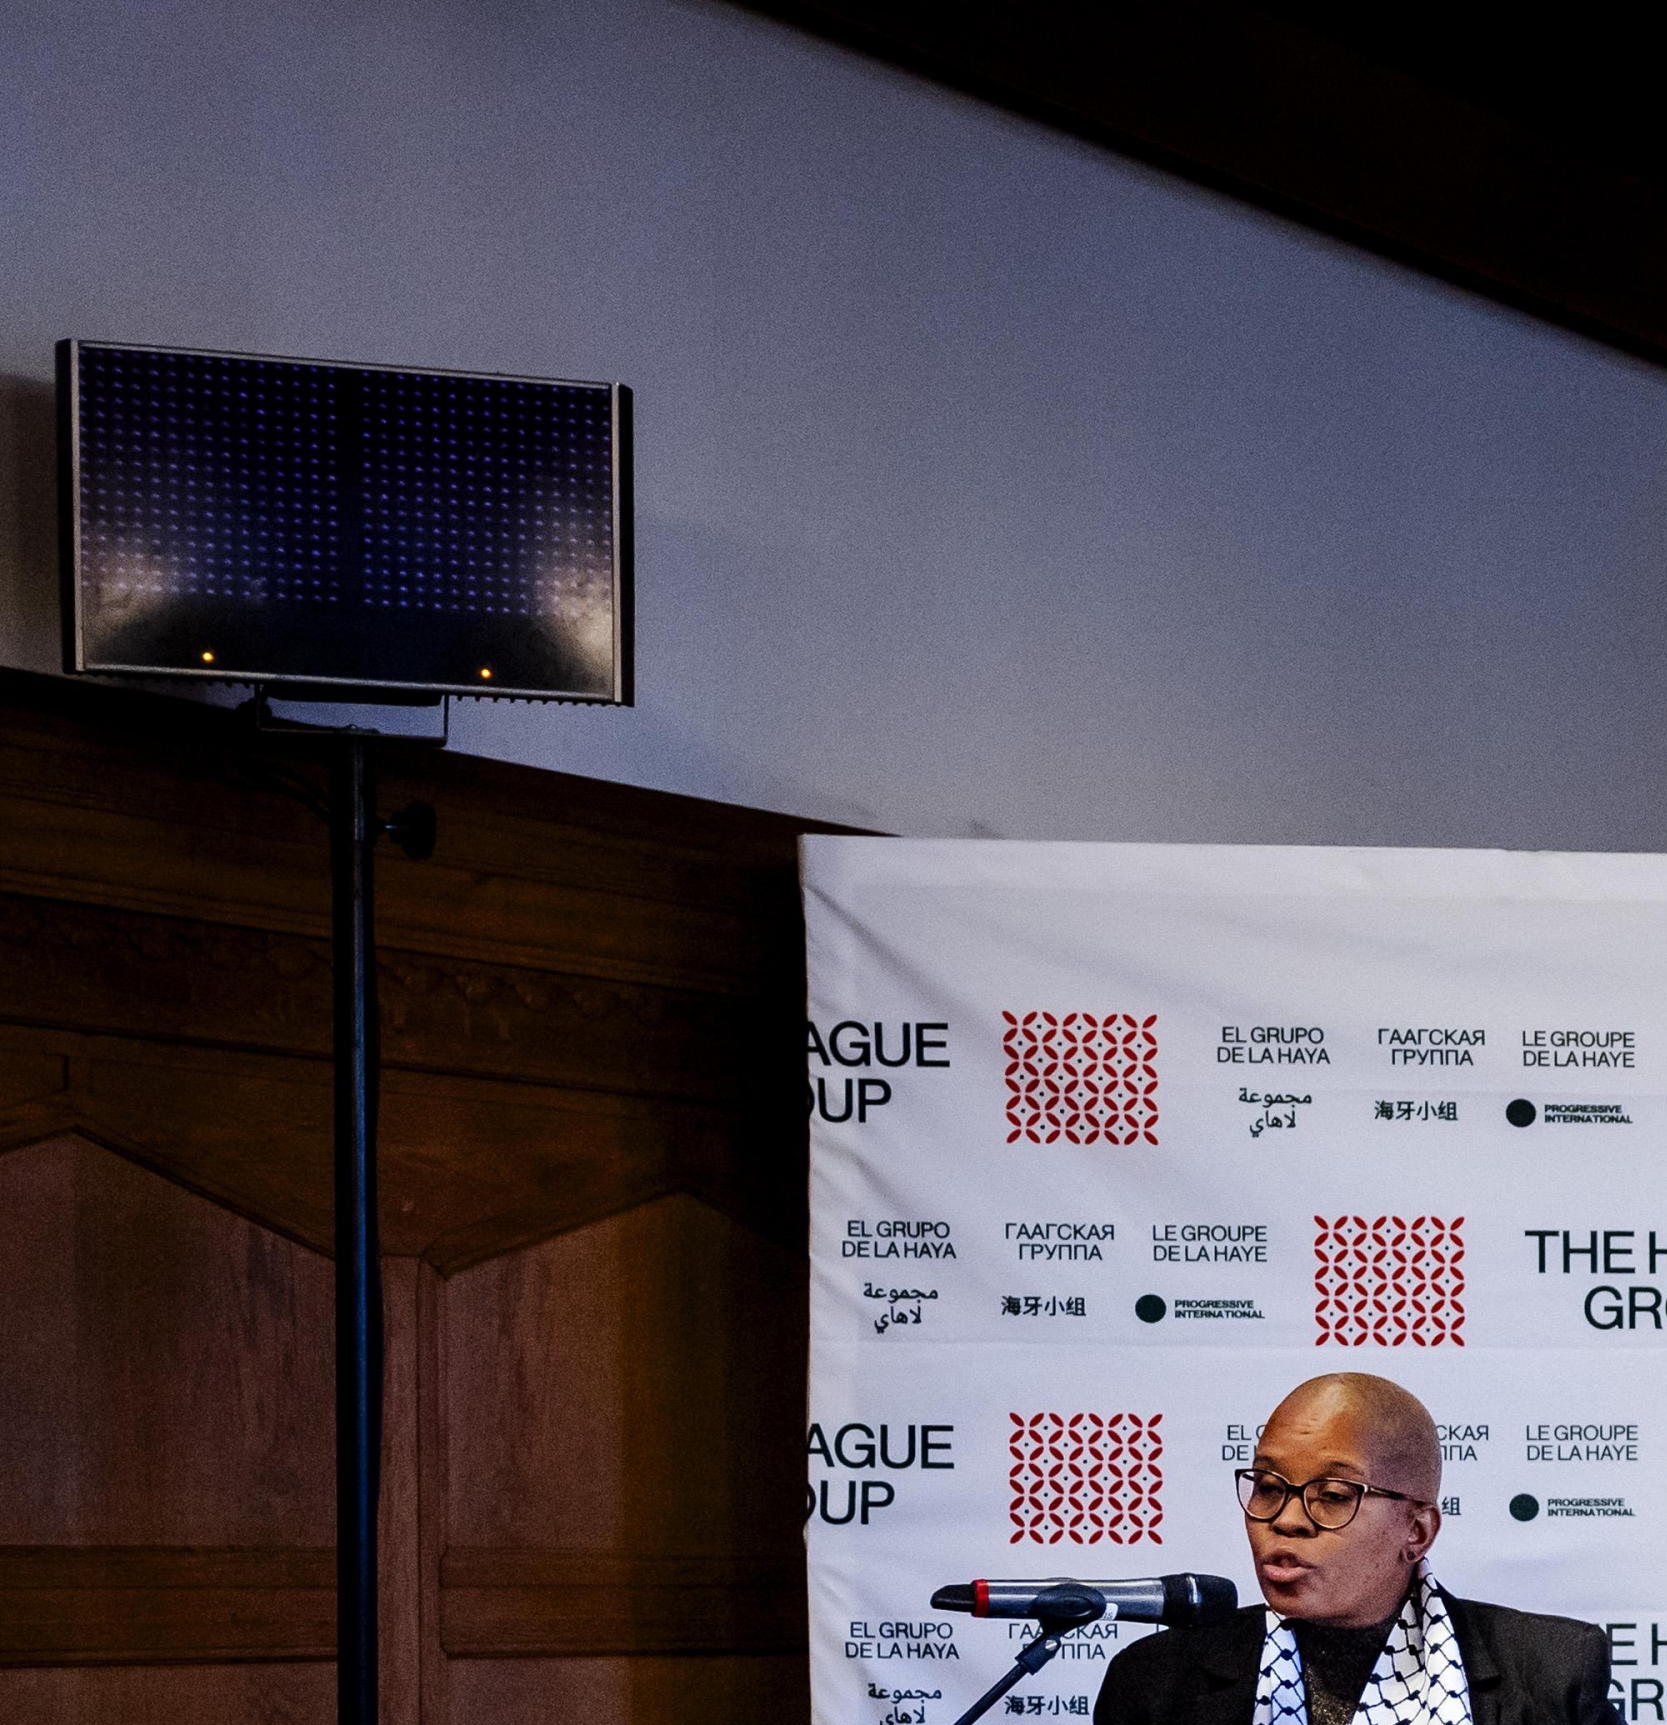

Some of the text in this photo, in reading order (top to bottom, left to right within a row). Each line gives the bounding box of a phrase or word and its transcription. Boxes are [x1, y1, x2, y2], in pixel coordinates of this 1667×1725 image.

[807, 1020, 951, 1068] AGUE
[1221, 1026, 1325, 1045] EL GRUPO
[1377, 1028, 1486, 1046] ГААГСКАЯ
[1522, 1030, 1635, 1049] LE GROUPE
[1217, 1046, 1331, 1065] DE LA HAYA
[1391, 1048, 1474, 1067] ГРУППА
[1523, 1049, 1635, 1069] DE LA HAYE
[1238, 1087, 1313, 1109] مجموعة
[1374, 1099, 1459, 1121] 海牙小组
[1544, 1103, 1623, 1114] PROGRESSIVE
[1249, 1109, 1297, 1139] لاهاي
[1544, 1113, 1633, 1124] INTERNATIONAL
[847, 1219, 951, 1239] EL GRUPO
[1005, 1222, 1115, 1241] ГААГСКАЯ
[1152, 1224, 1268, 1243] LE GROUPE
[841, 1240, 957, 1259] DE LA HAYA
[1019, 1243, 1103, 1261] ГРУППА
[1153, 1244, 1268, 1263] DE LA HAYE
[1523, 1228, 1637, 1276] THE
[863, 1282, 939, 1305] مجموعة
[1000, 1295, 1087, 1317] 海牙小组
[1174, 1299, 1254, 1309] PROGRESSIVE
[873, 1305, 922, 1335] لاهاي
[1174, 1309, 1265, 1319] INTERNATIONAL
[1526, 1424, 1639, 1442] LE GROUPE
[807, 1422, 955, 1470] AGUE
[1527, 1444, 1638, 1461] DE LA HAYE
[1547, 1498, 1625, 1507] PROGRESSIVE
[1547, 1507, 1635, 1517] INTERNATIONAL
[850, 1621, 953, 1640] EL GRUPO
[844, 1641, 960, 1660] DE LA HAYA
[867, 1682, 943, 1705] مجموعة
[1004, 1694, 1090, 1716] 海牙小组
